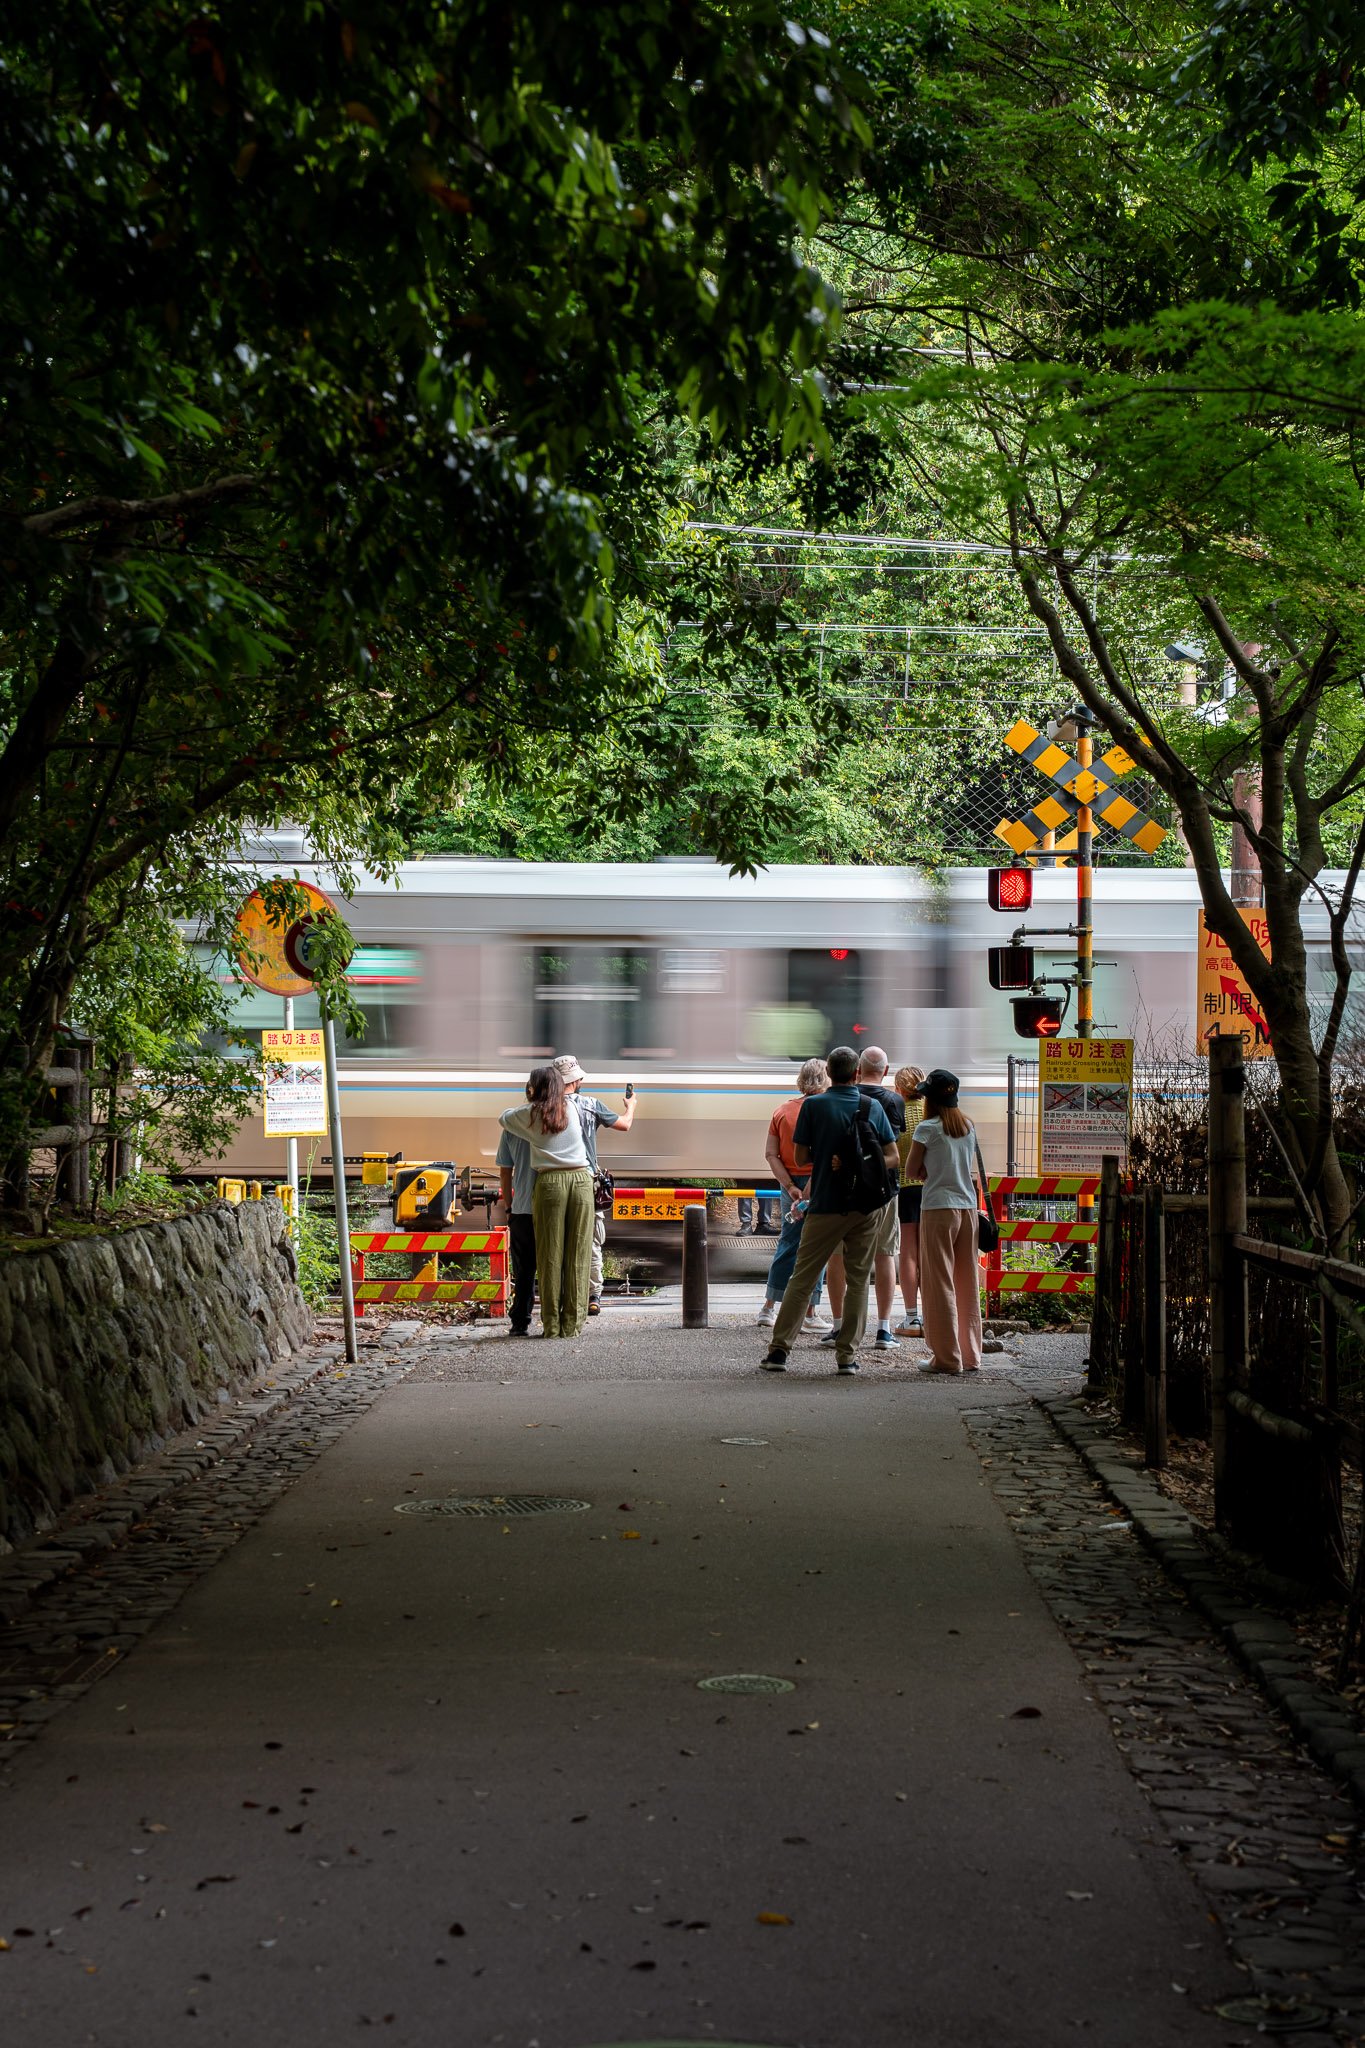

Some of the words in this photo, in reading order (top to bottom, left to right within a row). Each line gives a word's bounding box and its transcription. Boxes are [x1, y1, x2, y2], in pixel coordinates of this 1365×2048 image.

[267, 1032, 321, 1045] 踏切注意
[1046, 1042, 1127, 1059] 踏切注意
